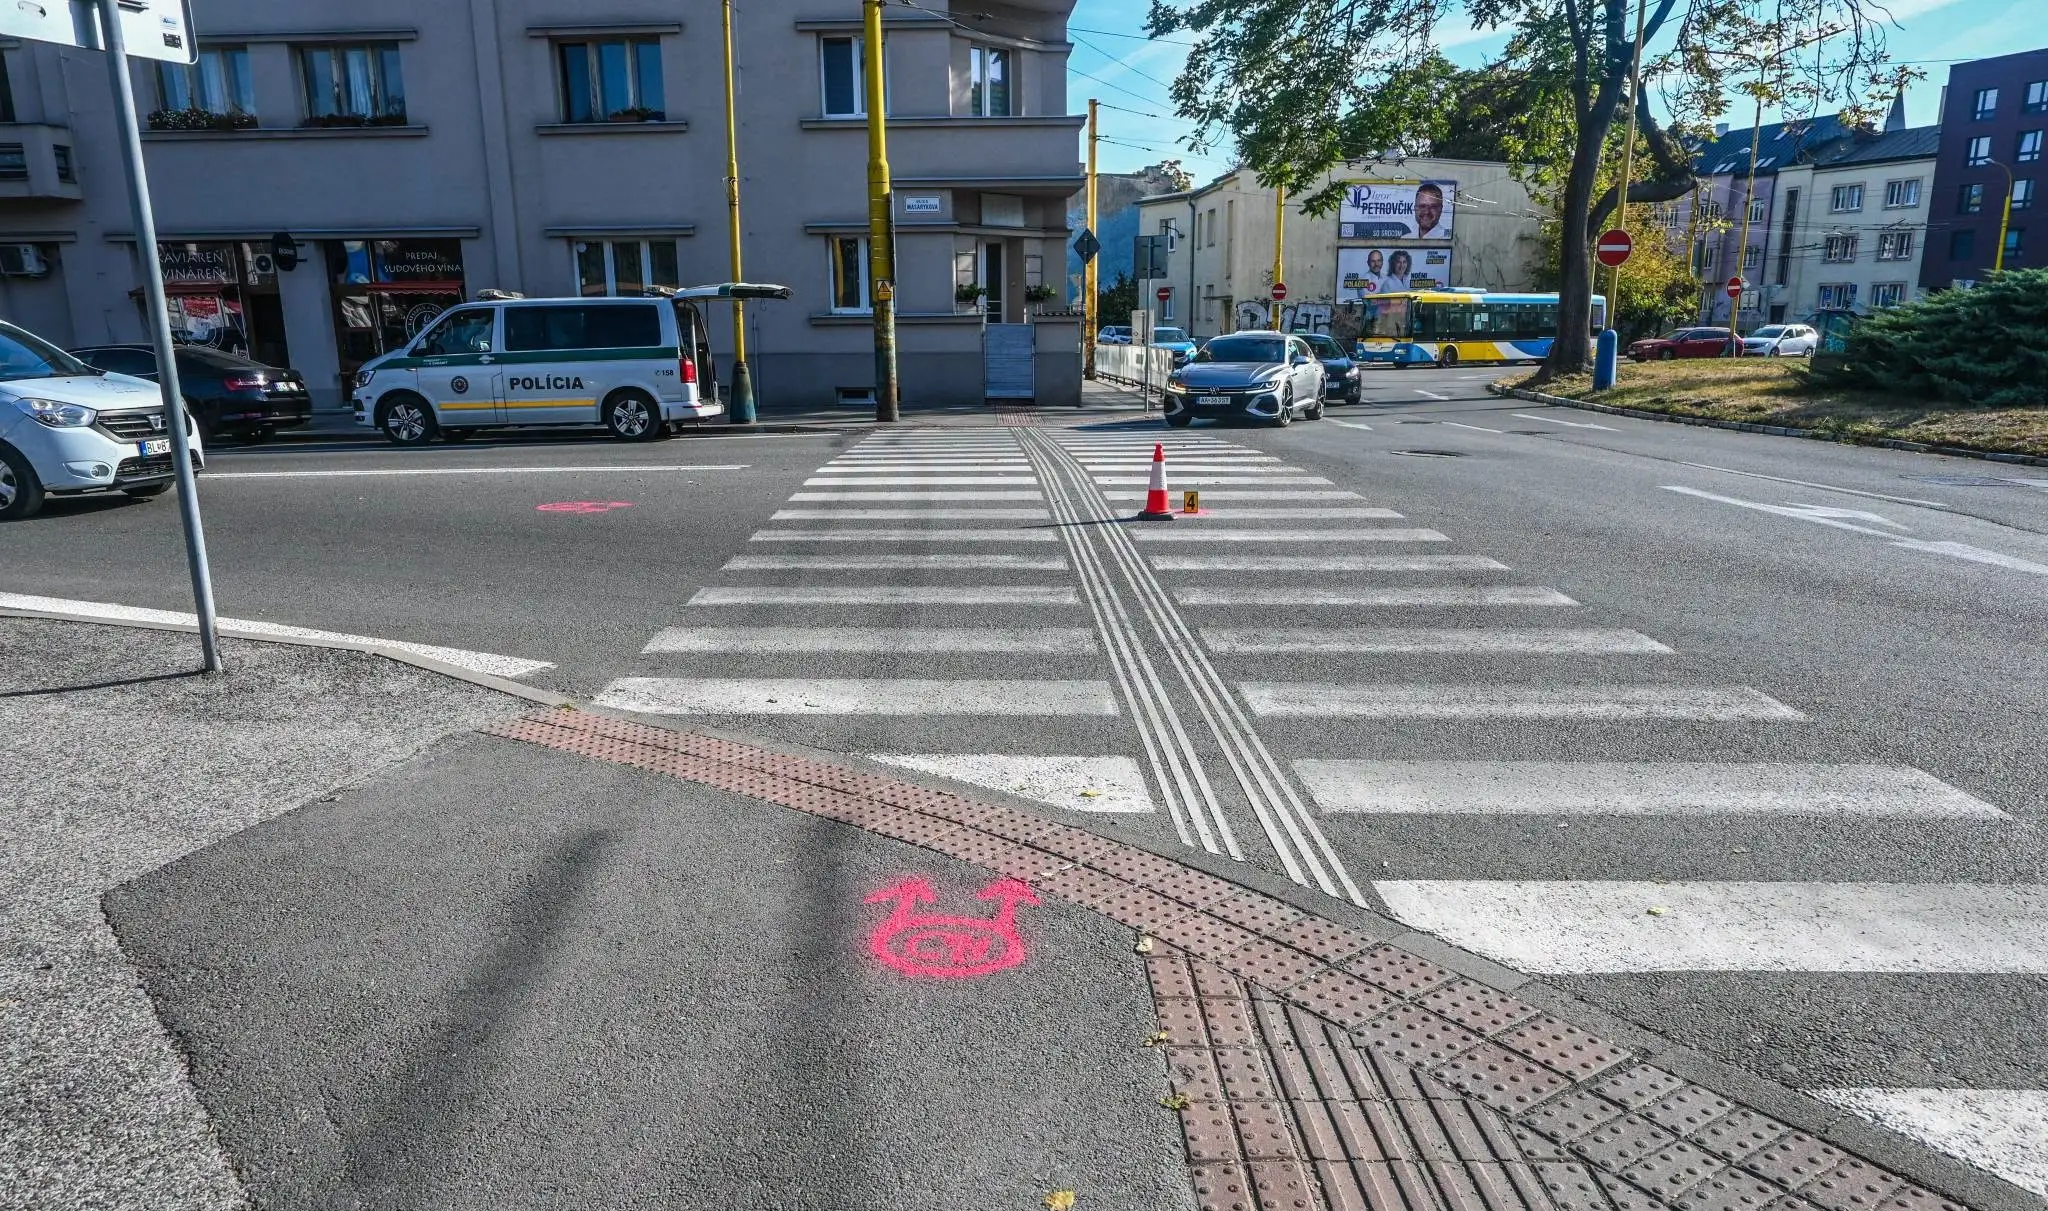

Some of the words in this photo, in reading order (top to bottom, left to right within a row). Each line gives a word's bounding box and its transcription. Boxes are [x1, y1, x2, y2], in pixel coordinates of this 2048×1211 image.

[1362, 199, 1414, 215] PETROVČIK
[405, 251, 438, 260] PREDAJ
[510, 374, 584, 391] POLÍCIA
[1186, 494, 1196, 510] 4
